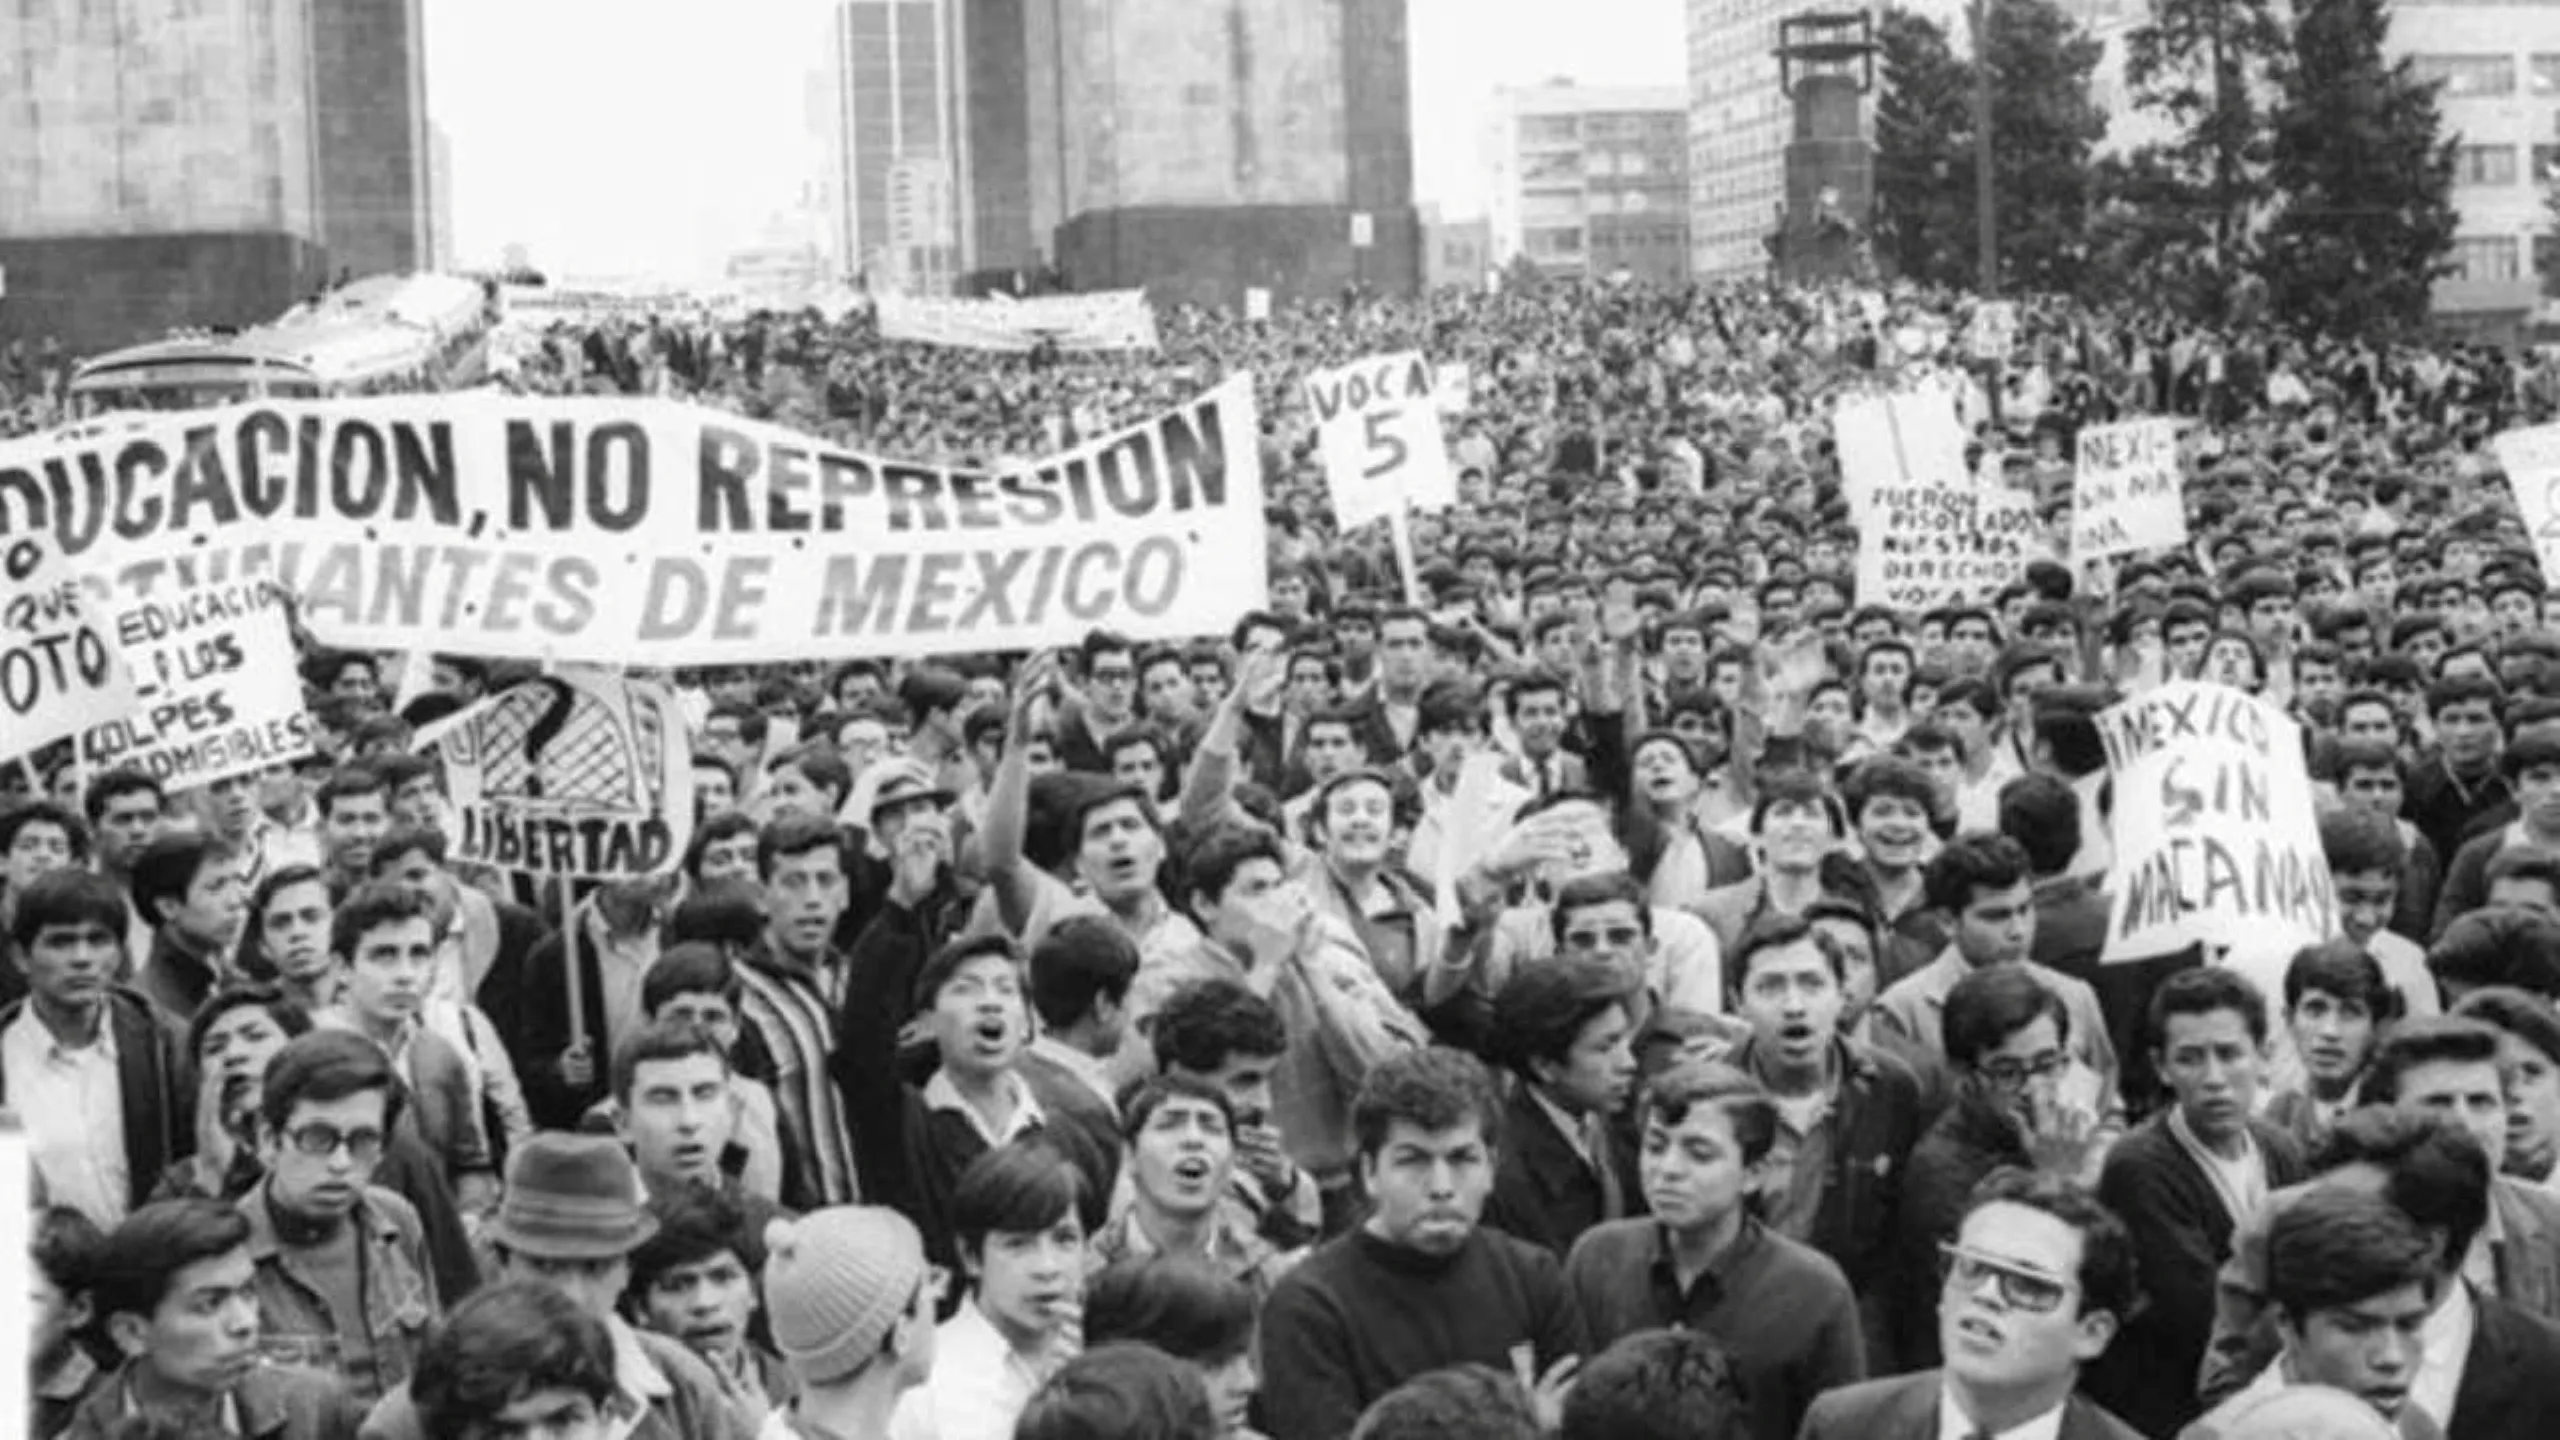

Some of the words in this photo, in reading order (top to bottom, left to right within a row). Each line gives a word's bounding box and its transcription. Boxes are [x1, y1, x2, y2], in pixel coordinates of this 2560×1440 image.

[1311, 358, 1430, 422] VOCA
[506, 419, 650, 532] NO
[697, 401, 1227, 532] REPRESION
[1362, 409, 1409, 480] 5
[638, 556, 772, 641] DE
[812, 534, 1184, 636] MEXICO
[176, 630, 246, 681] LOS
[2162, 754, 2270, 826] SIN
